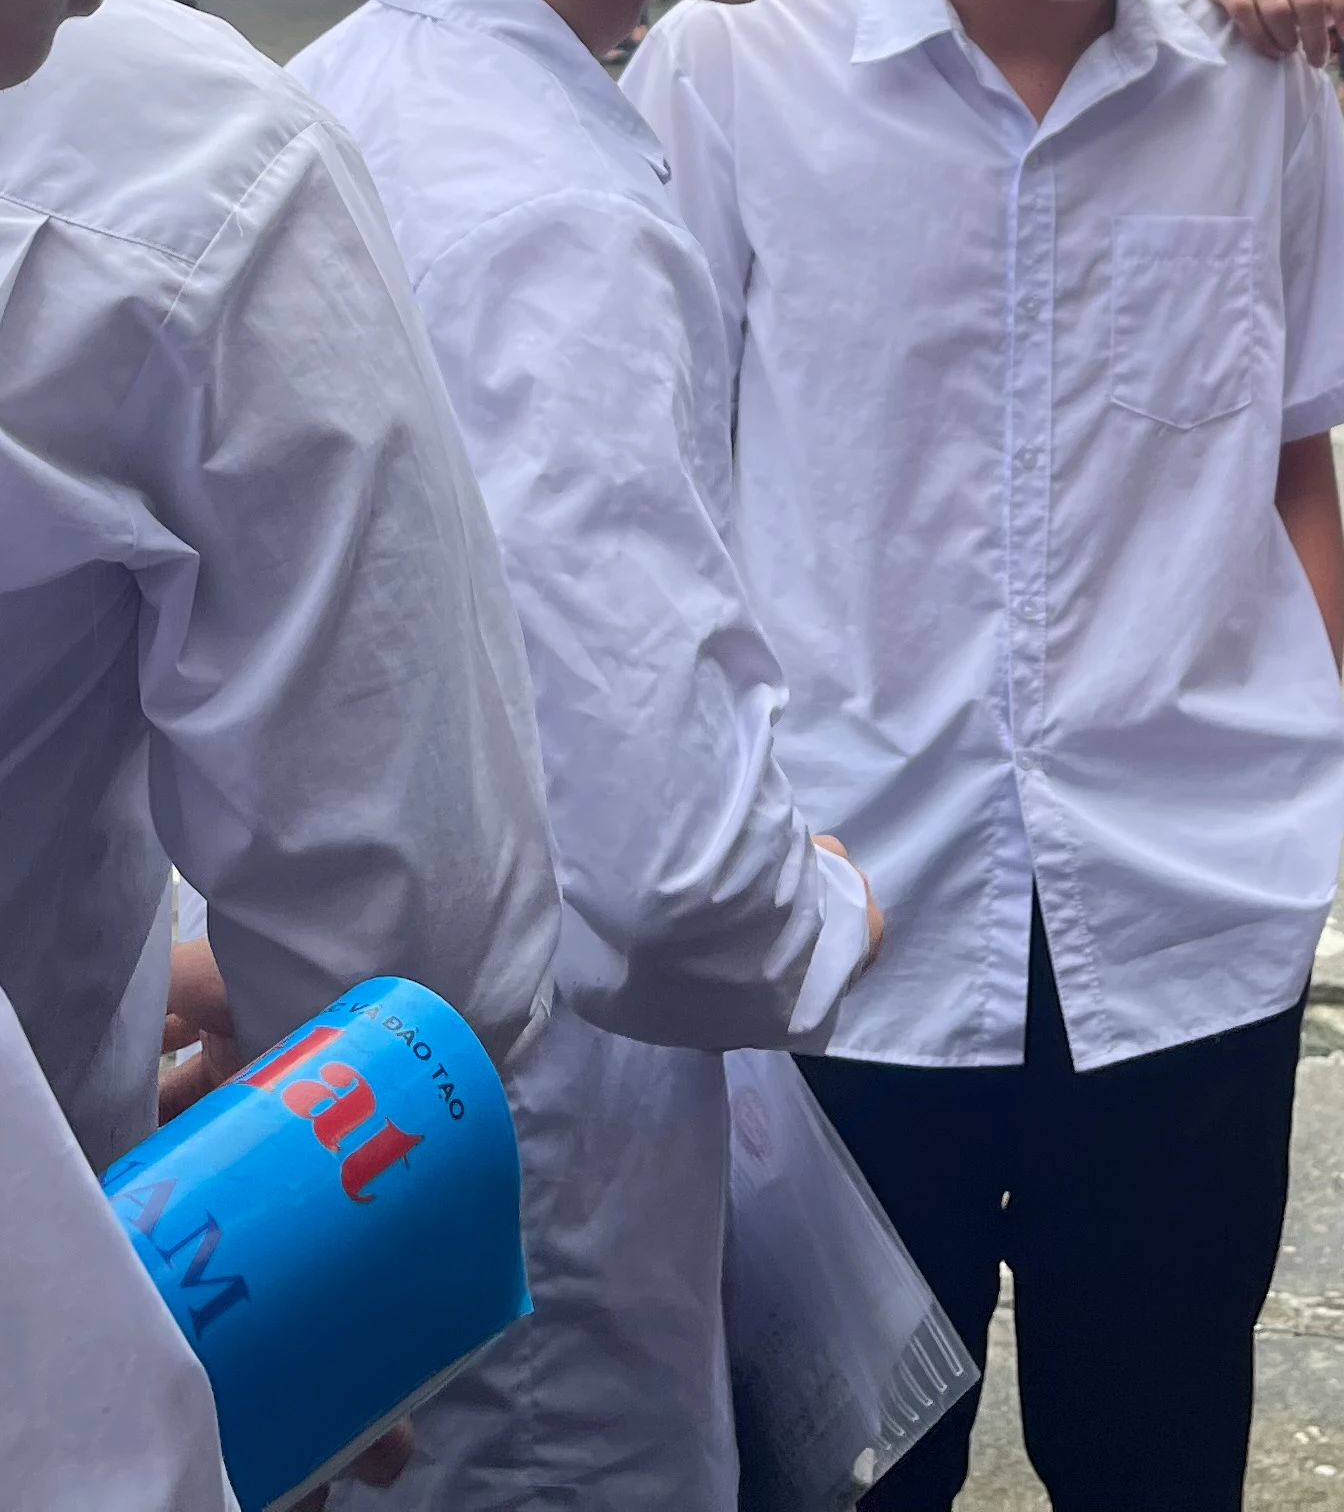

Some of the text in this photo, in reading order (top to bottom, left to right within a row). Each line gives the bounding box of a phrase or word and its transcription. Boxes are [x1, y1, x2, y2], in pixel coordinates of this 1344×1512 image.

[236, 1025, 425, 1203] lat
[382, 1016, 432, 1061] ĐÀO
[431, 1062, 465, 1120] TẠO
